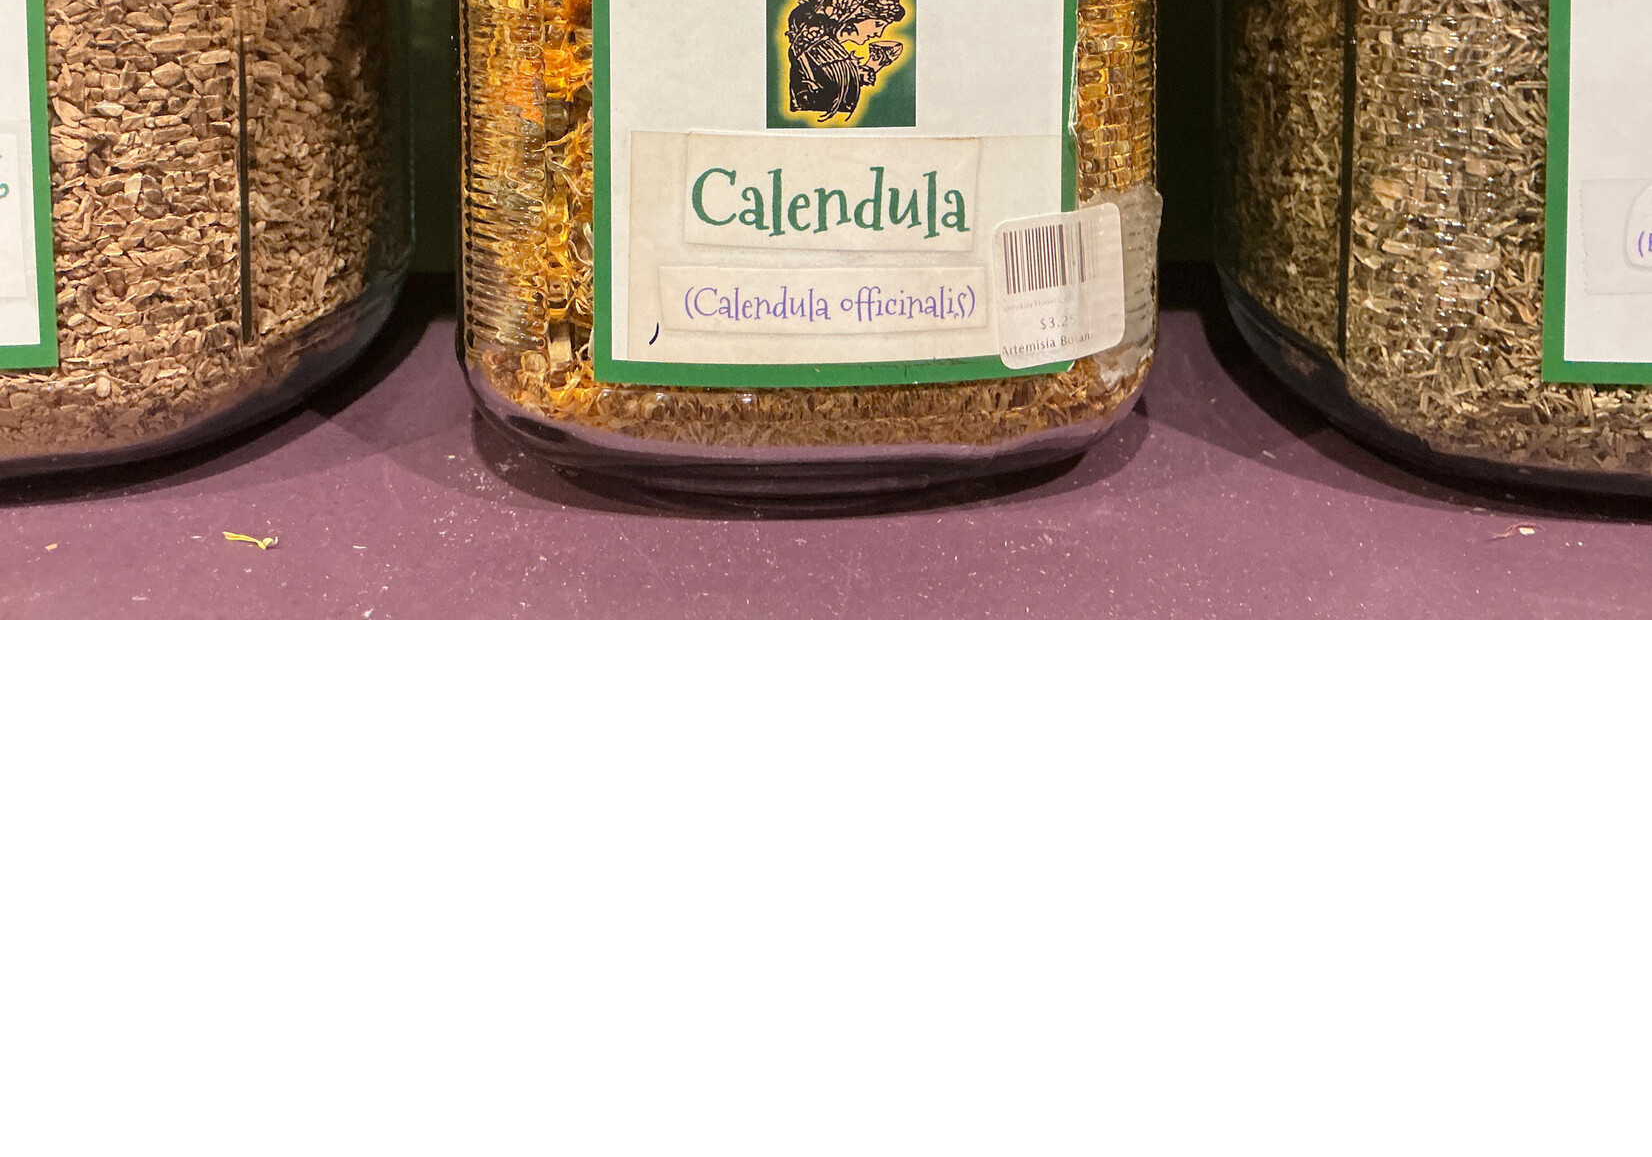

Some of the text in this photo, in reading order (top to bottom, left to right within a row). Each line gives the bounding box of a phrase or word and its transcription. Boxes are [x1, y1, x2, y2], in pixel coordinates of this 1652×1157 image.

[691, 166, 971, 239] Calendula
[684, 285, 976, 322] (Calendula officinalis)
[1002, 338, 1056, 356] Artemisia
